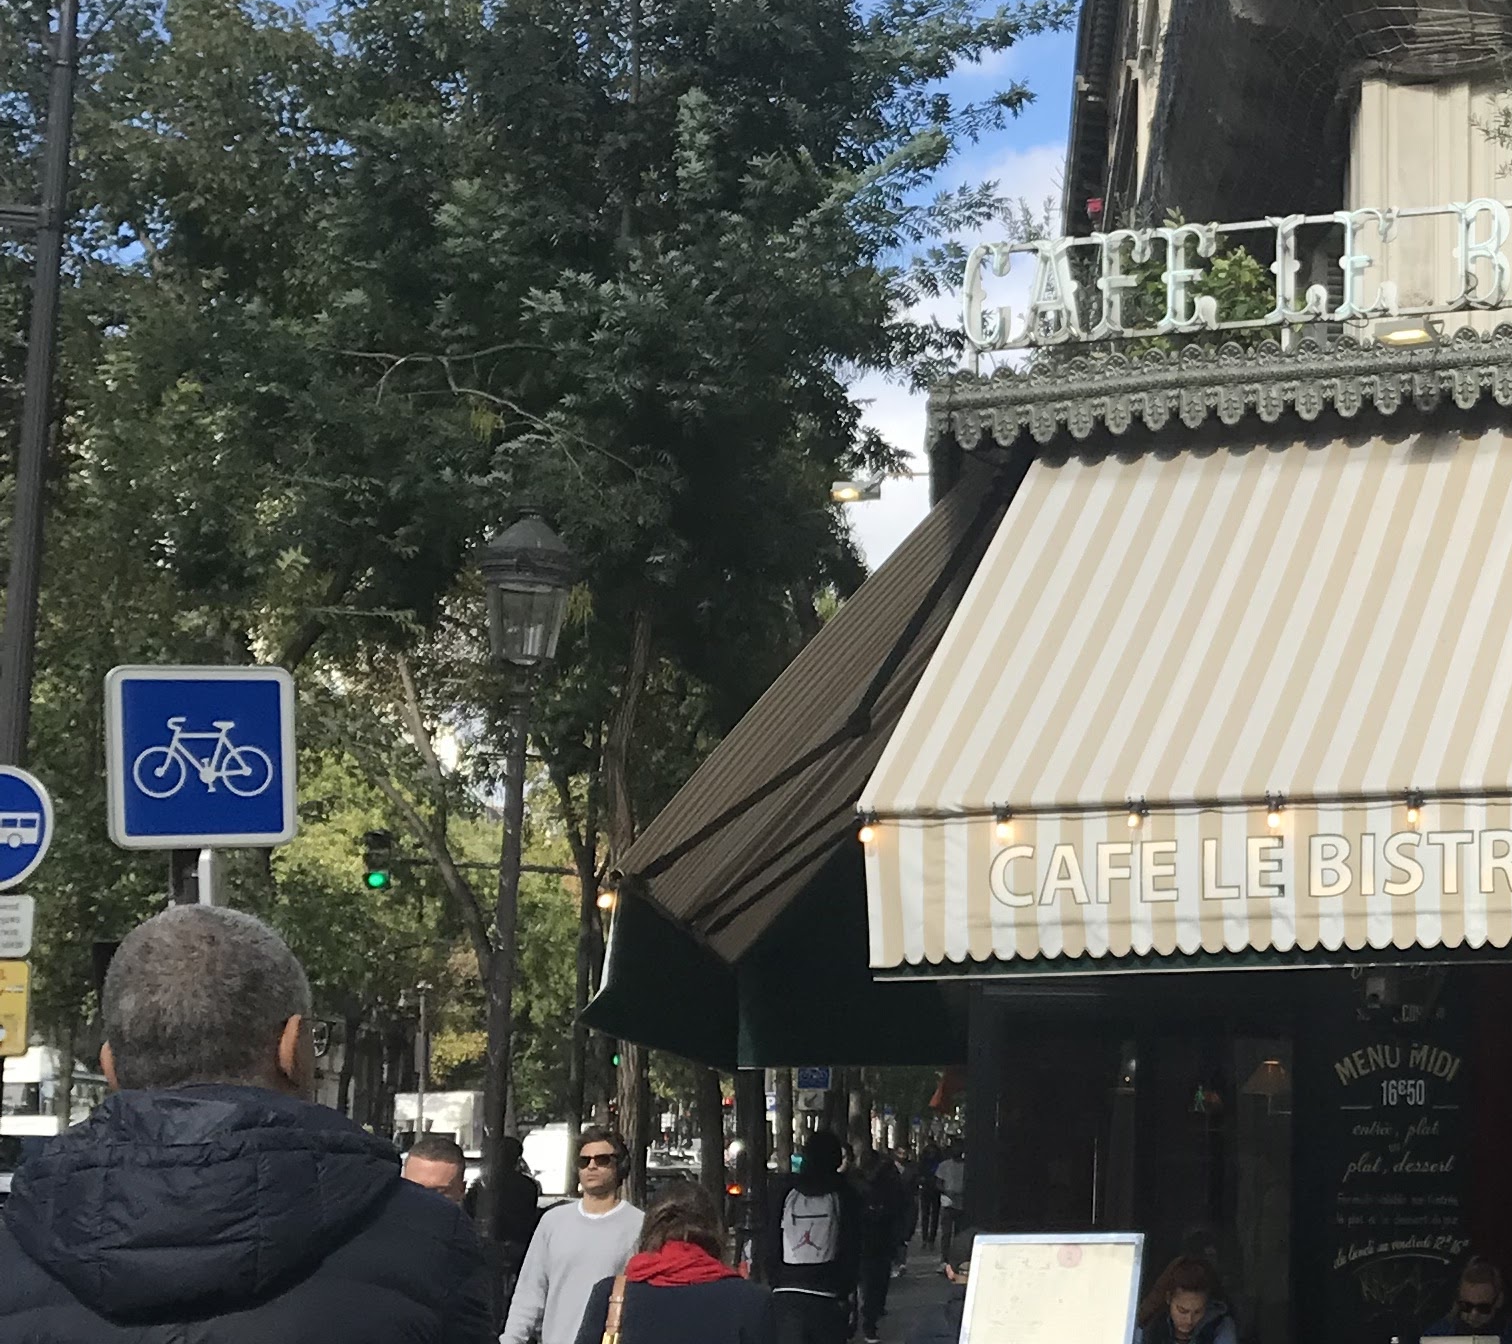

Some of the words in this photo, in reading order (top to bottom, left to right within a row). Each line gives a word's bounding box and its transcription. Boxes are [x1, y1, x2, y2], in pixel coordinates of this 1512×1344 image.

[961, 220, 1220, 350] CAFE
[1265, 206, 1400, 325] LE
[988, 835, 1180, 910] CAFE
[1199, 833, 1287, 902] LE
[1334, 1043, 1400, 1087] MENU
[1409, 1042, 1461, 1083] MIDI
[1404, 1116, 1440, 1144] plat
[1392, 1150, 1456, 1173] dessert
